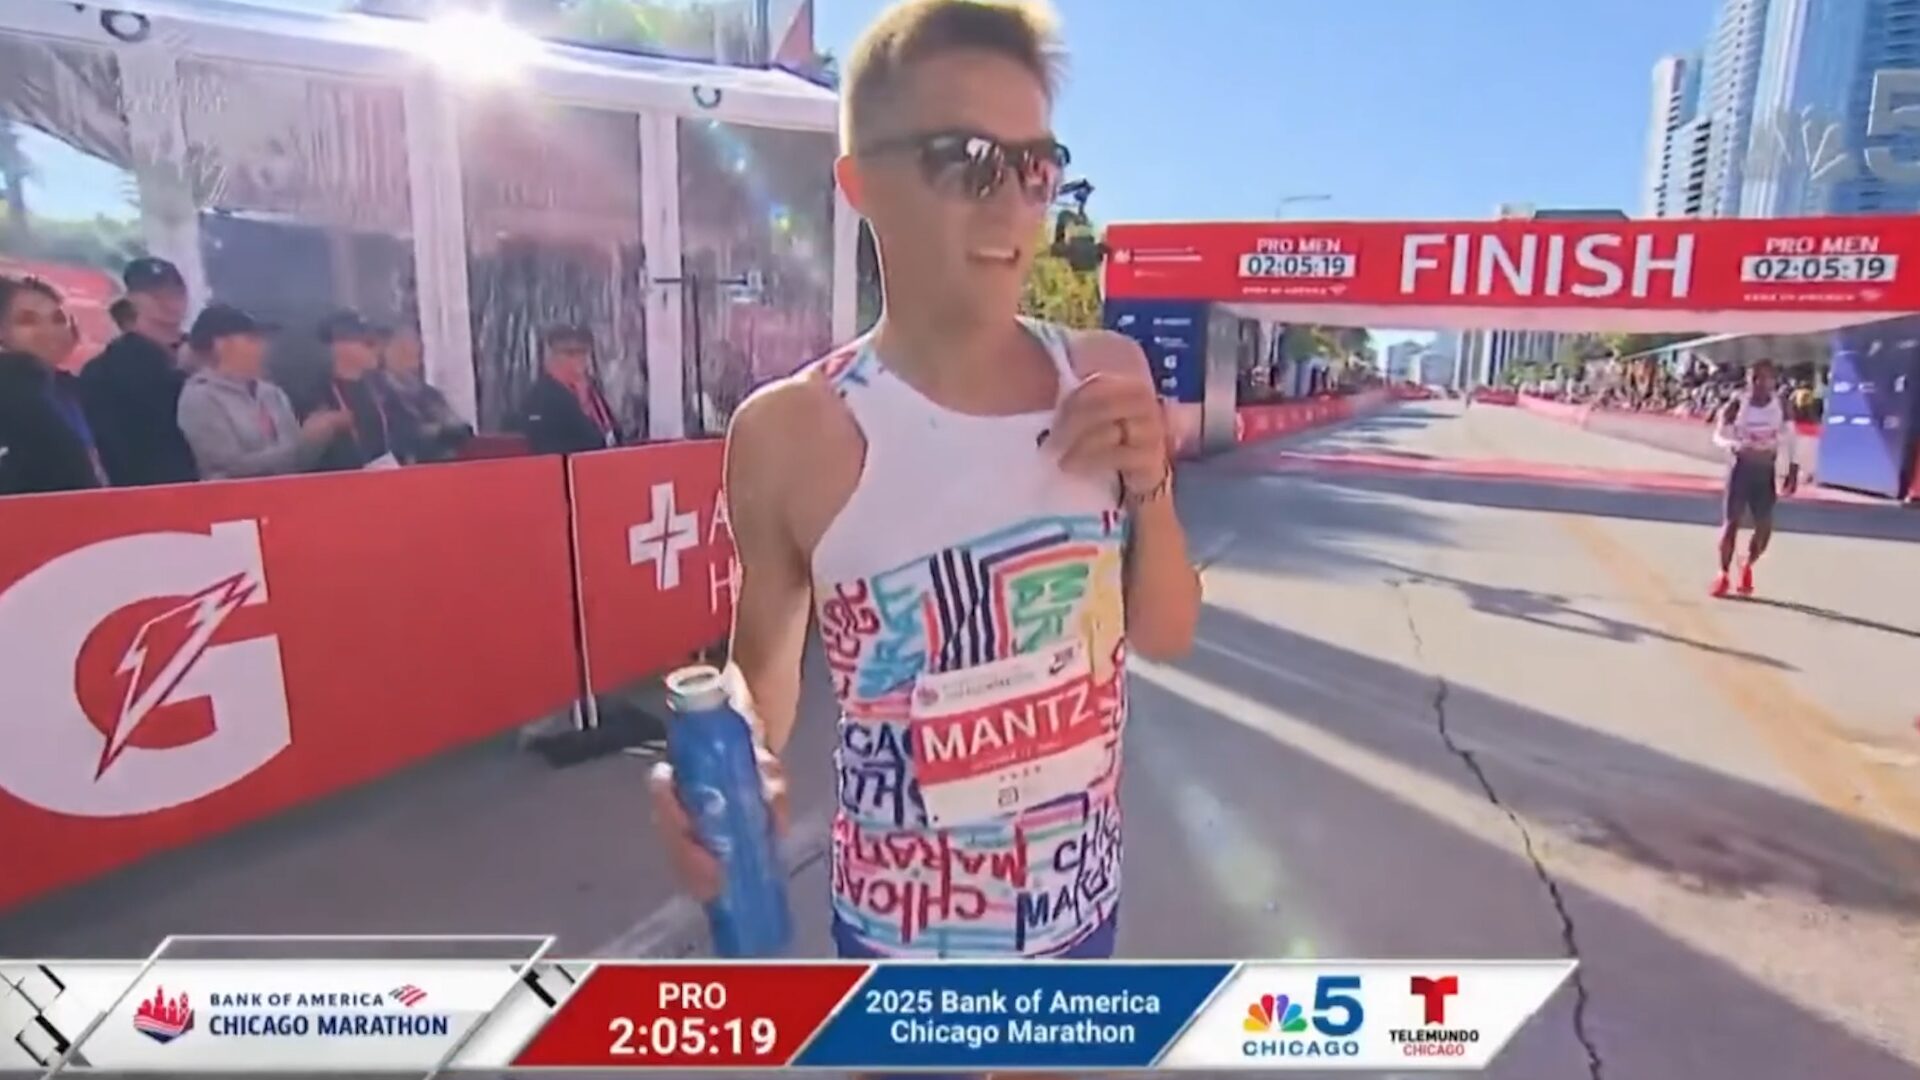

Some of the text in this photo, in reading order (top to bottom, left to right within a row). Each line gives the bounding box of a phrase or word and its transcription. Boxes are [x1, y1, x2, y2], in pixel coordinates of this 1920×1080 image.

[1256, 238, 1342, 253] PRO MEN
[1765, 236, 1880, 254] PRO MEN
[1246, 255, 1346, 277] 02:05:19
[1400, 232, 1695, 299] FINISH
[1753, 256, 1886, 281] 02:05:19
[921, 680, 1095, 765] MANTZ
